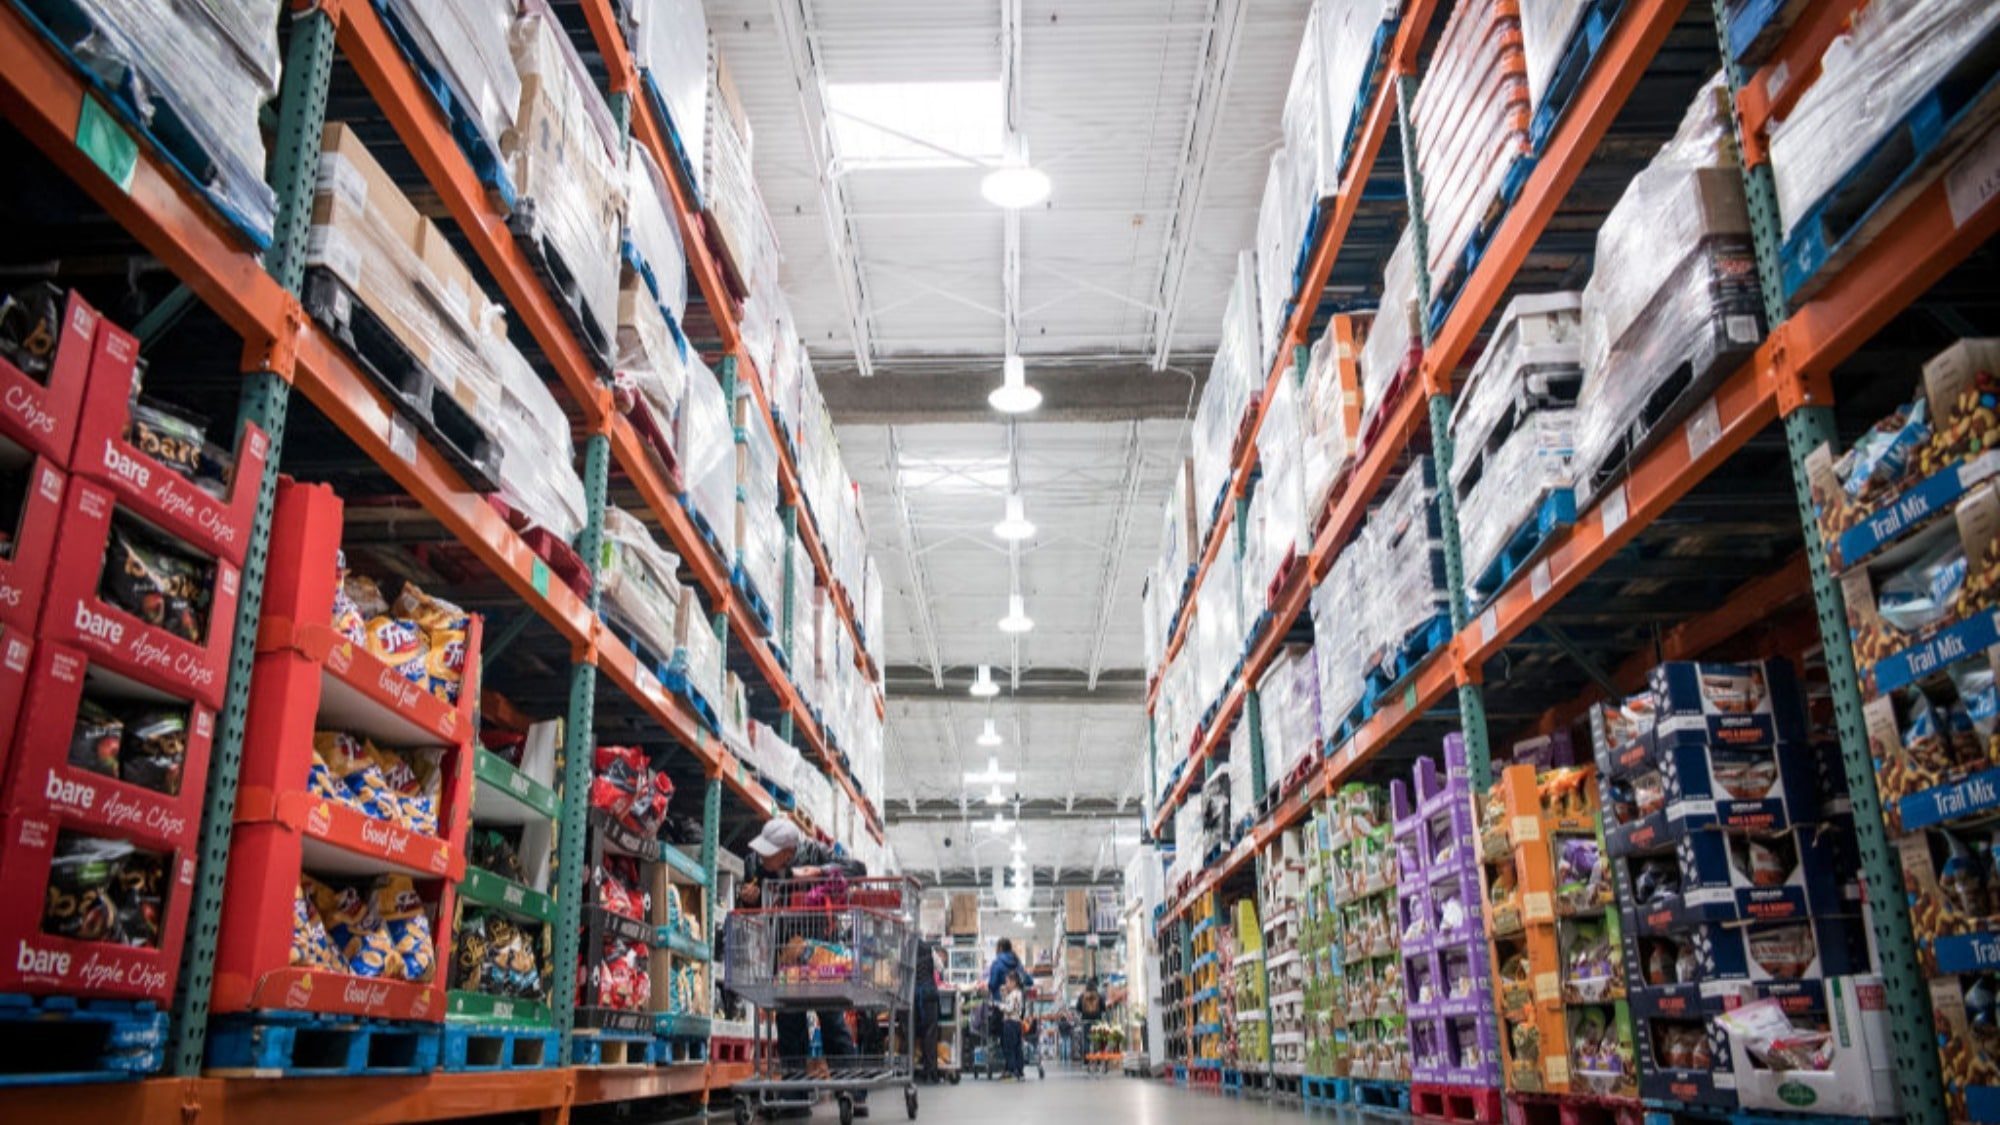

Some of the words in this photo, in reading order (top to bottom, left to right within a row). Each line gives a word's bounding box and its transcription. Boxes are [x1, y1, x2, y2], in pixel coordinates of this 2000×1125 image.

[5, 386, 56, 433] Chips
[104, 438, 150, 488] bare
[156, 481, 194, 518] Apple
[199, 507, 235, 542] Chips
[1869, 510, 1900, 541] Trail
[1900, 493, 1929, 523] Mix
[75, 600, 123, 644] bare
[130, 632, 171, 666] Apple
[175, 652, 213, 684] Chips
[1906, 643, 1936, 675] Trail
[1937, 634, 1965, 660] Mix
[45, 769, 96, 808] bare
[101, 791, 142, 824] Apple
[146, 805, 186, 838] Chips
[1933, 786, 1964, 816] Trail
[1967, 778, 1997, 805] Mix
[17, 940, 71, 976] bare
[80, 954, 124, 988] Apple
[128, 963, 168, 994] Chips
[1970, 935, 2000, 964] Trai
